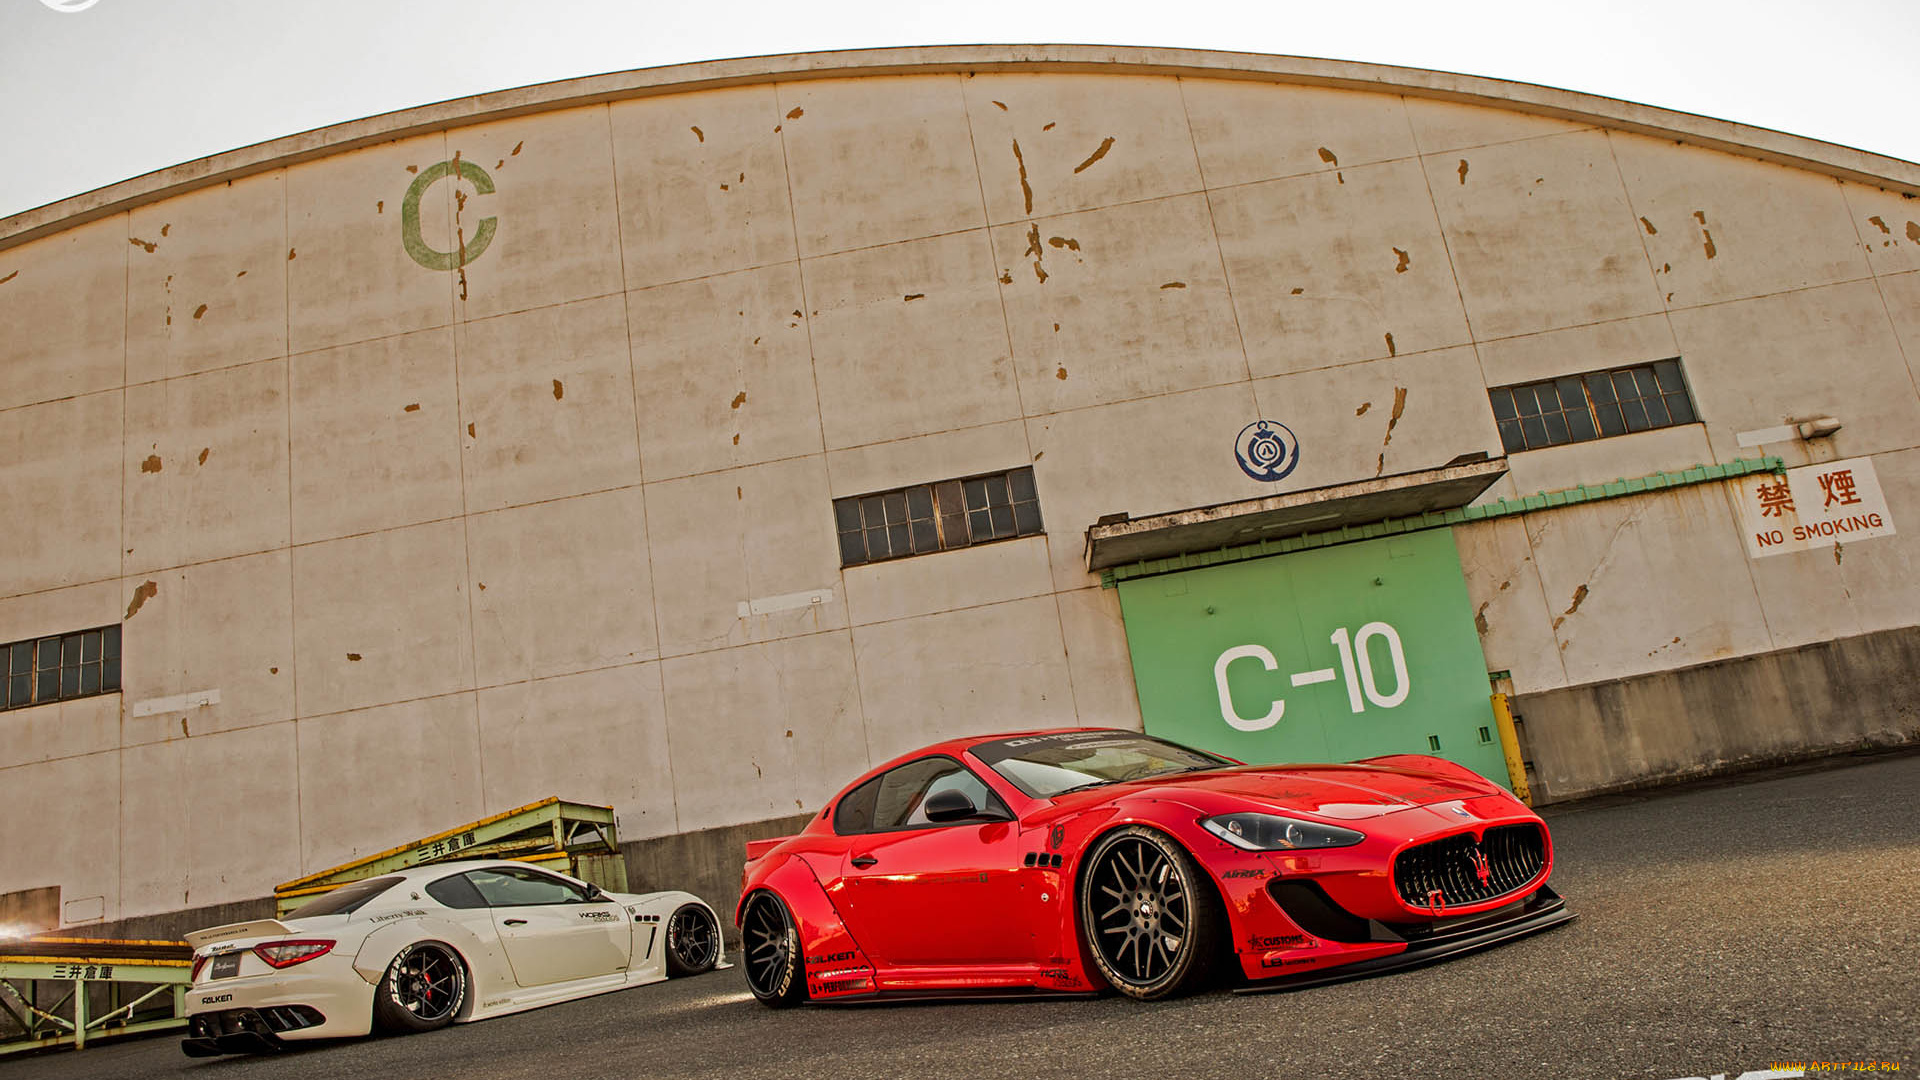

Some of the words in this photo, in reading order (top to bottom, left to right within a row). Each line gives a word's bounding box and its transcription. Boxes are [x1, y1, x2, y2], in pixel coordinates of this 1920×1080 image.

[402, 159, 497, 271] C
[1756, 530, 1784, 548] NO
[1792, 513, 1883, 541] SMOKING
[1213, 621, 1410, 732] C-10
[417, 829, 477, 862] 三井倉庫
[53, 965, 113, 980] 三井倉庫
[806, 951, 856, 965] FALKEN
[202, 994, 233, 1005] FALKEN
